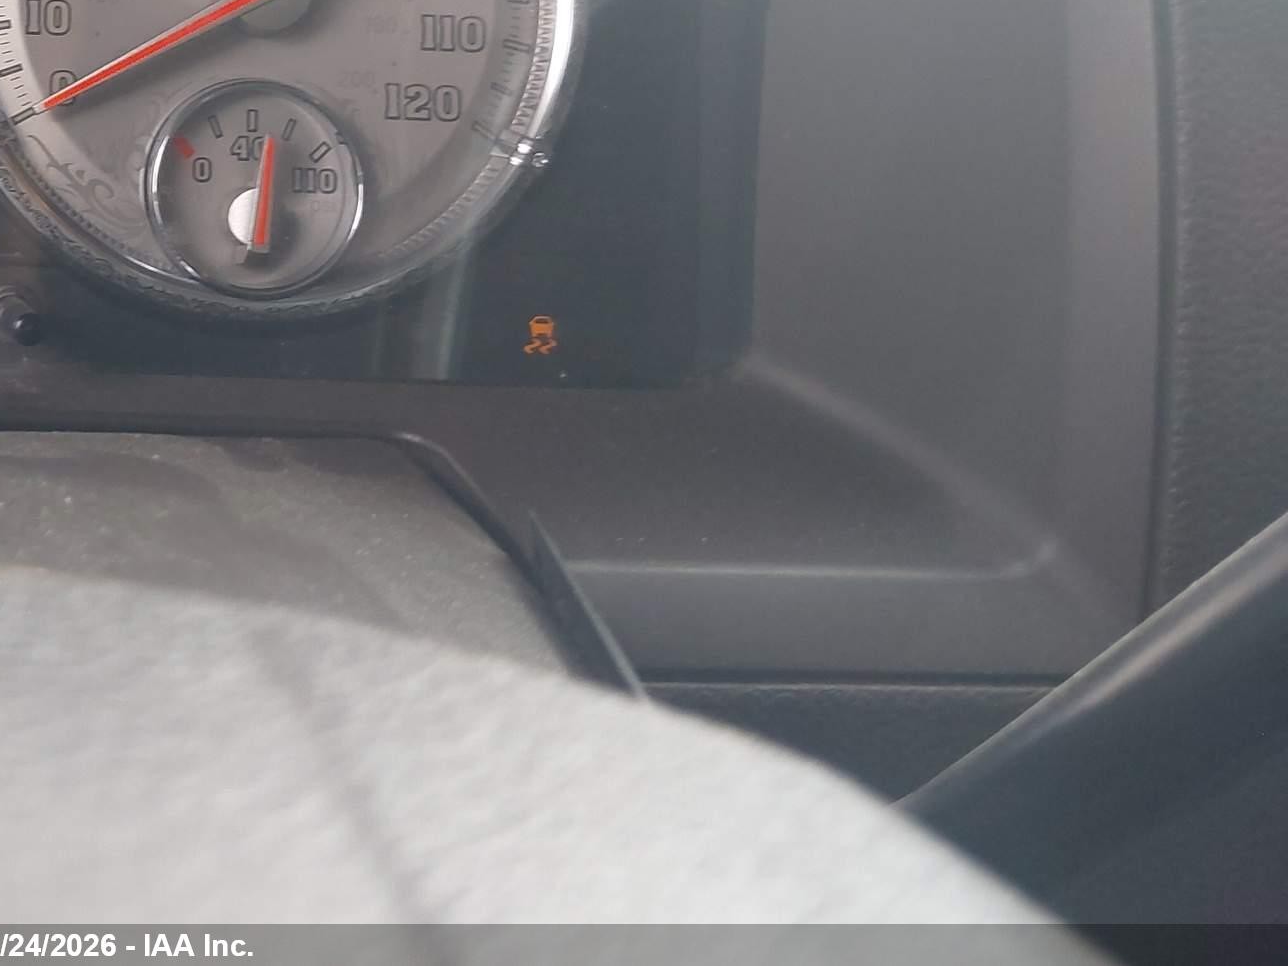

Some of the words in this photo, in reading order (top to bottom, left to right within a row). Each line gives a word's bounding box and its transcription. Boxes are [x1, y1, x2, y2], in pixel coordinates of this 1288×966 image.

[420, 14, 486, 53] 110
[384, 83, 462, 122] 120
[192, 157, 212, 183] 0
[292, 168, 337, 194] 110
